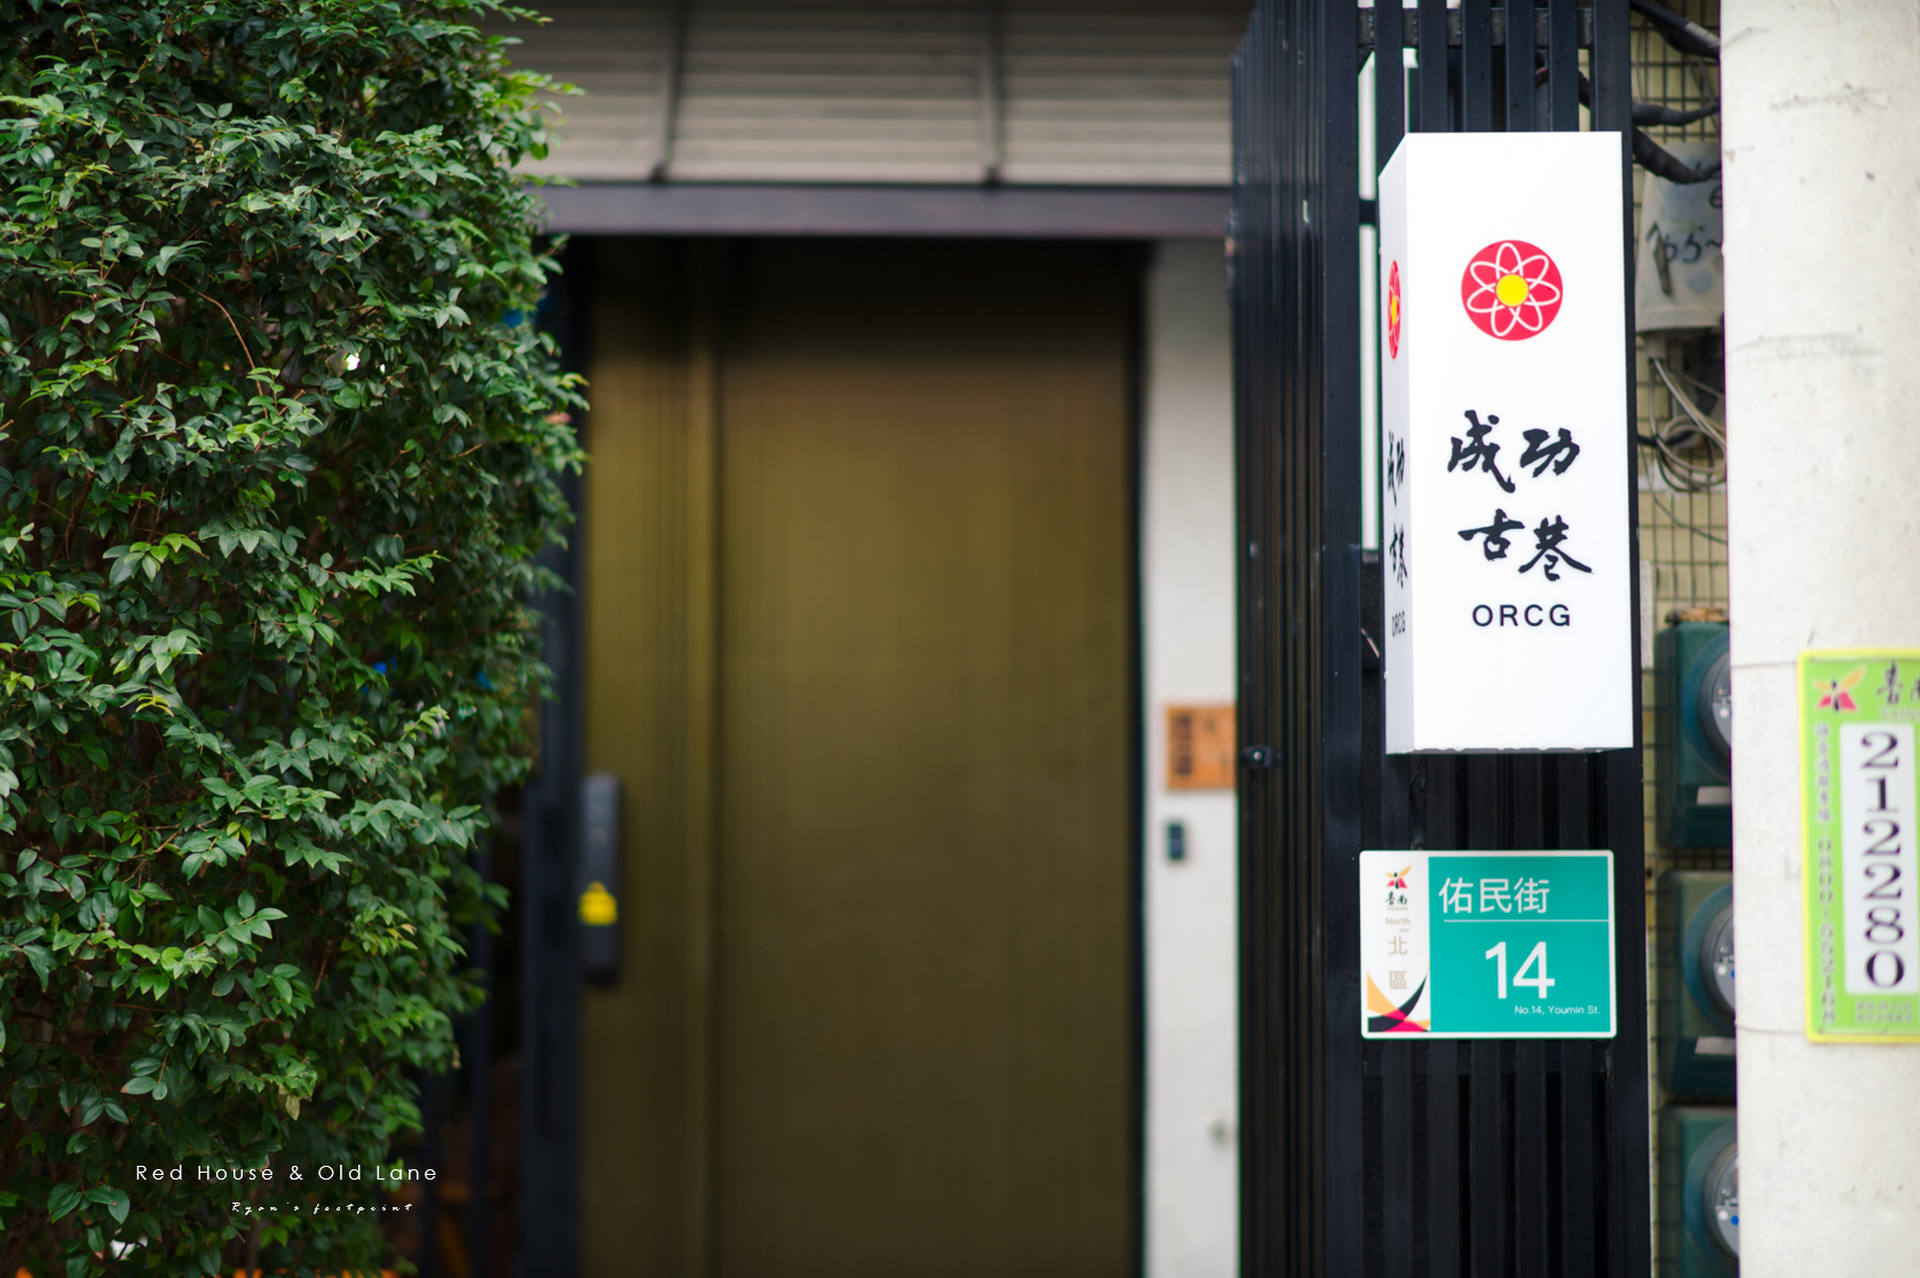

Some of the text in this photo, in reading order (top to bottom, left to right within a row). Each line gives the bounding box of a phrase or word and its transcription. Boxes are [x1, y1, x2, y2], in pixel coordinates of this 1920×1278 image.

[1447, 409, 1581, 494] 成功
[1457, 508, 1594, 582] 古巷
[1471, 603, 1571, 627] ORCG
[1861, 731, 1905, 988] 212280
[1438, 877, 1550, 914] 佑民街
[1388, 935, 1409, 990] 北區
[1485, 941, 1556, 1000] 14
[1547, 1005, 1585, 1015] Youmin
